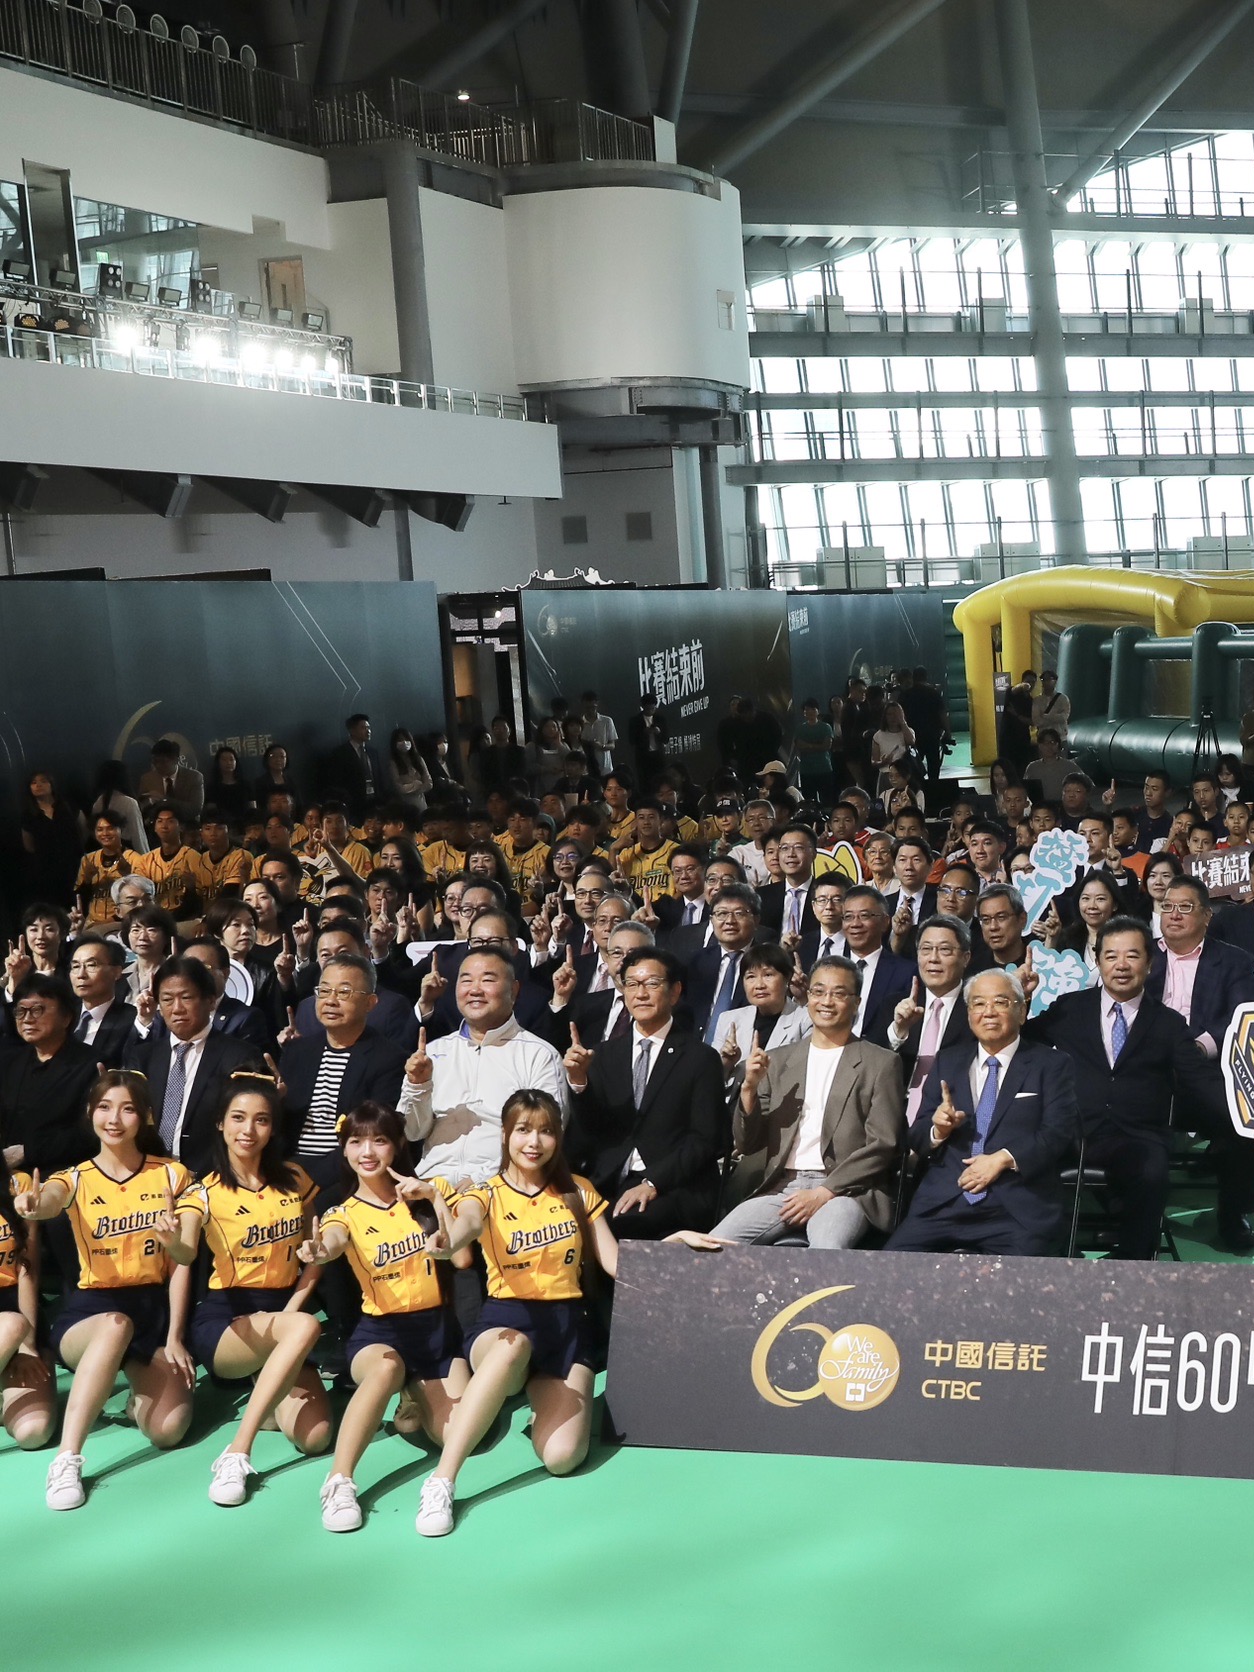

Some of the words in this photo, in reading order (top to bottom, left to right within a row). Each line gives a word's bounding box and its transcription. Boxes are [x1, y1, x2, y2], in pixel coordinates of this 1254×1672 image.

[638, 639, 705, 708] 比賽結束前
[703, 696, 710, 710] UP
[1191, 852, 1251, 889] 比賽結束
[373, 1231, 428, 1268] Brothe
[505, 1219, 579, 1256] Brothers
[563, 1248, 576, 1265] 6
[846, 1335, 874, 1354] We
[848, 1350, 880, 1366] care
[924, 1340, 1048, 1372] 中國信託
[818, 1359, 900, 1393] Family
[921, 1379, 982, 1401] CTBC
